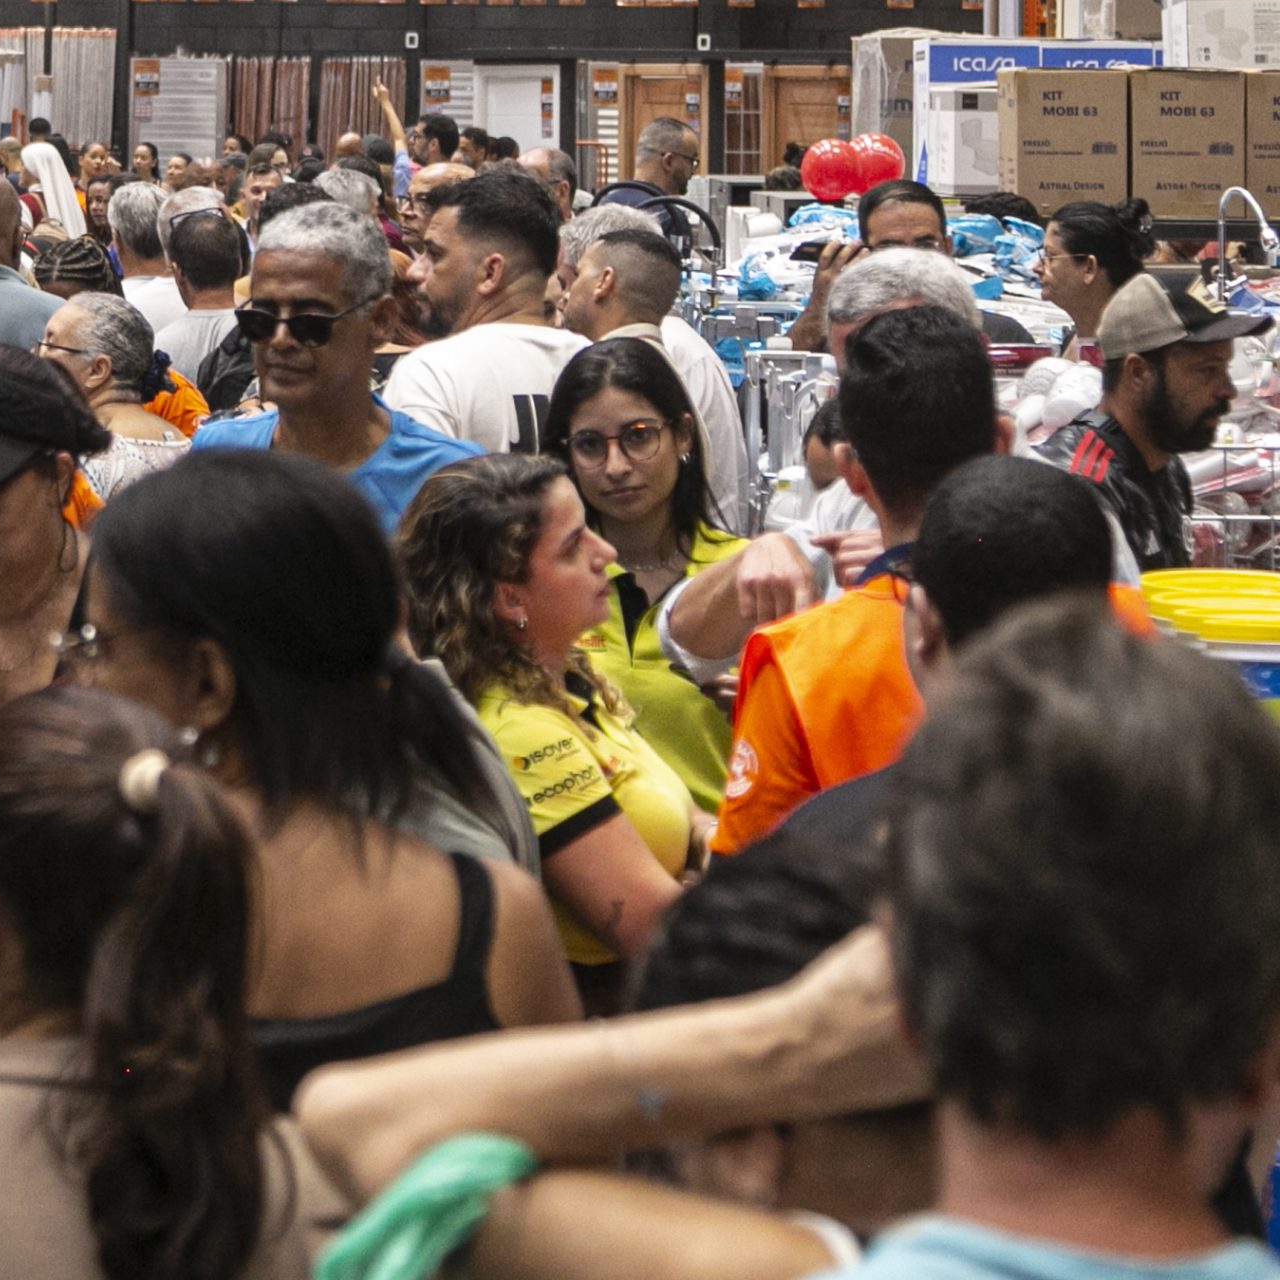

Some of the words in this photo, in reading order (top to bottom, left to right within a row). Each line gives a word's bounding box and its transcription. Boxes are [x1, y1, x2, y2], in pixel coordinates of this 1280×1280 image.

[1043, 91, 1063, 101] KIT
[1160, 91, 1180, 101] KIT
[1043, 107, 1079, 117] MOBI
[1083, 107, 1098, 117] 63
[1160, 107, 1196, 117] MOBI
[1200, 107, 1215, 117] 63
